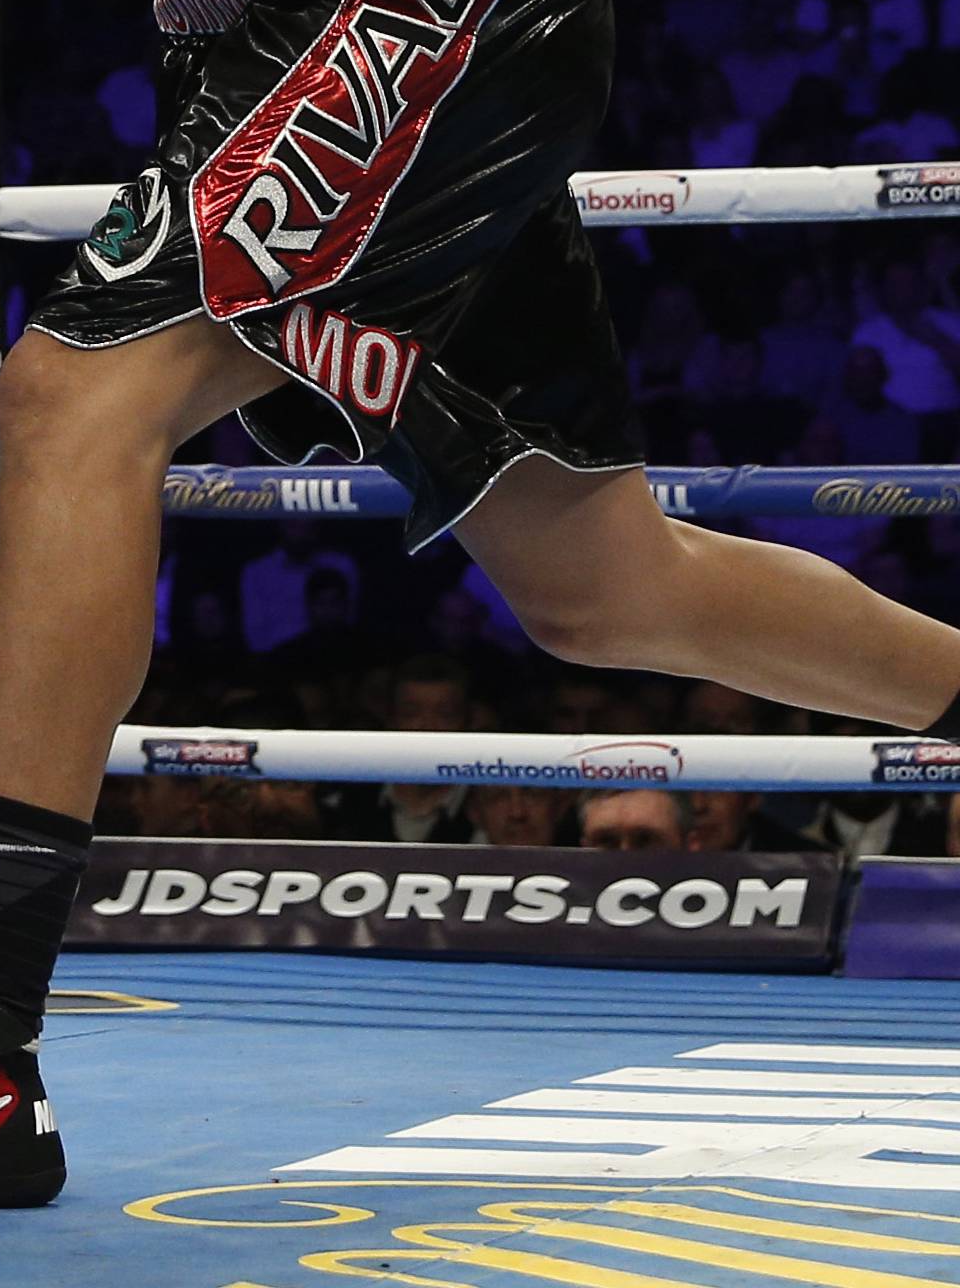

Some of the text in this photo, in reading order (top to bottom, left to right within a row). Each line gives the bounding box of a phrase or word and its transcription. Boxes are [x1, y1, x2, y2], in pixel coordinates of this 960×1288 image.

[889, 186, 928, 204] BOX
[280, 478, 359, 512] HILL
[437, 757, 669, 782] matchroomboxing
[883, 765, 924, 782] BOX
[93, 869, 809, 928] JDSPORTS.COM
